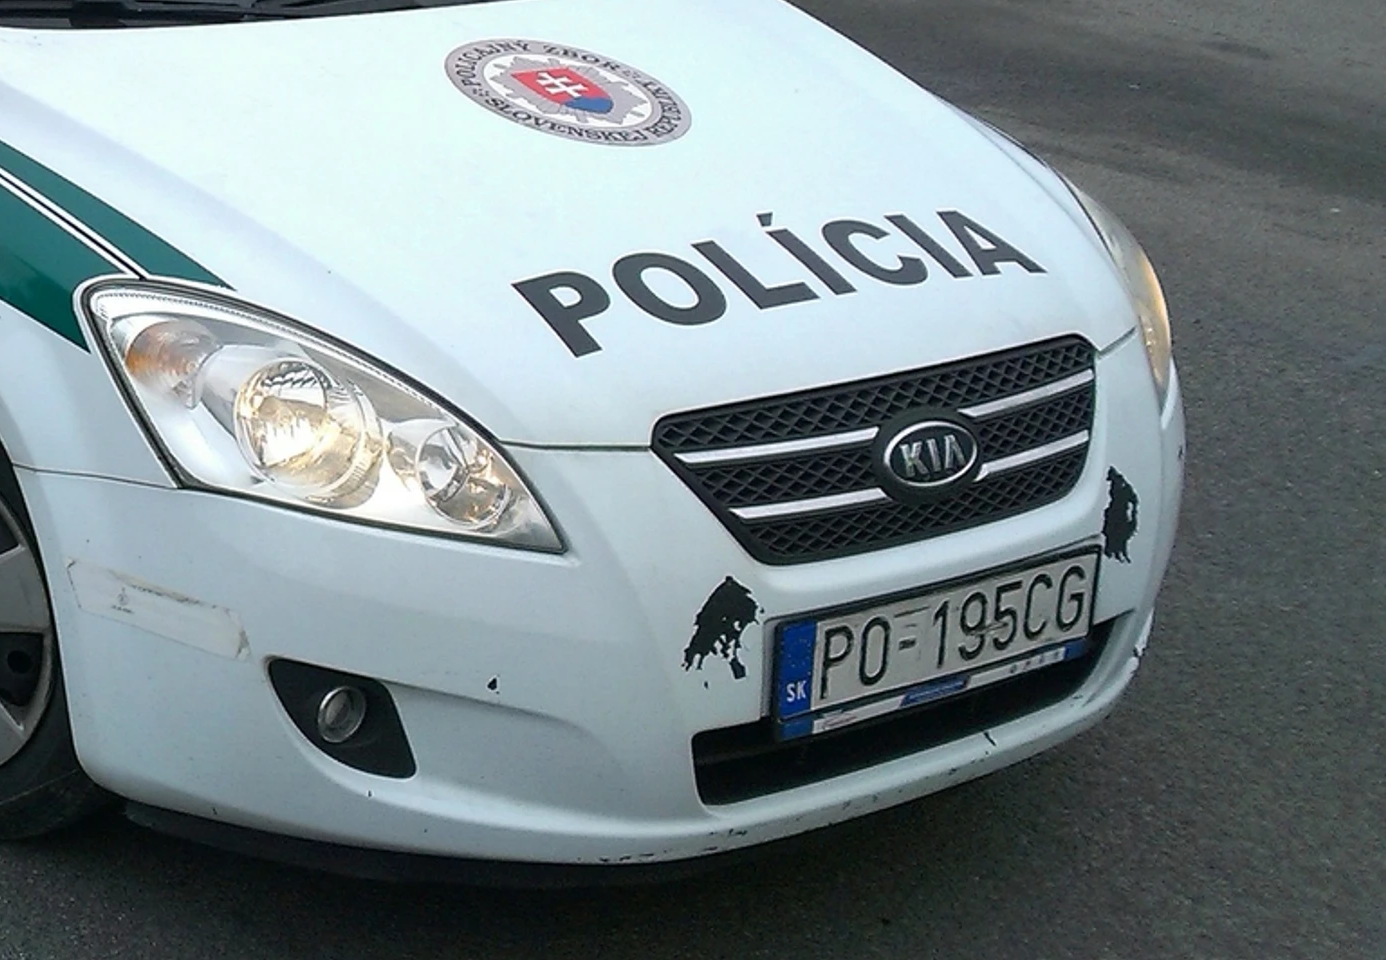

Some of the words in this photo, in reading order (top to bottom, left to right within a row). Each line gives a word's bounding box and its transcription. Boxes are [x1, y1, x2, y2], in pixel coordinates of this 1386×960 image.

[485, 97, 648, 141] SLOVENSKEJ
[511, 210, 1048, 358] POLÍCIA
[899, 434, 967, 477] KIA
[819, 565, 1086, 700] PO-195CG
[786, 680, 807, 702] SK
